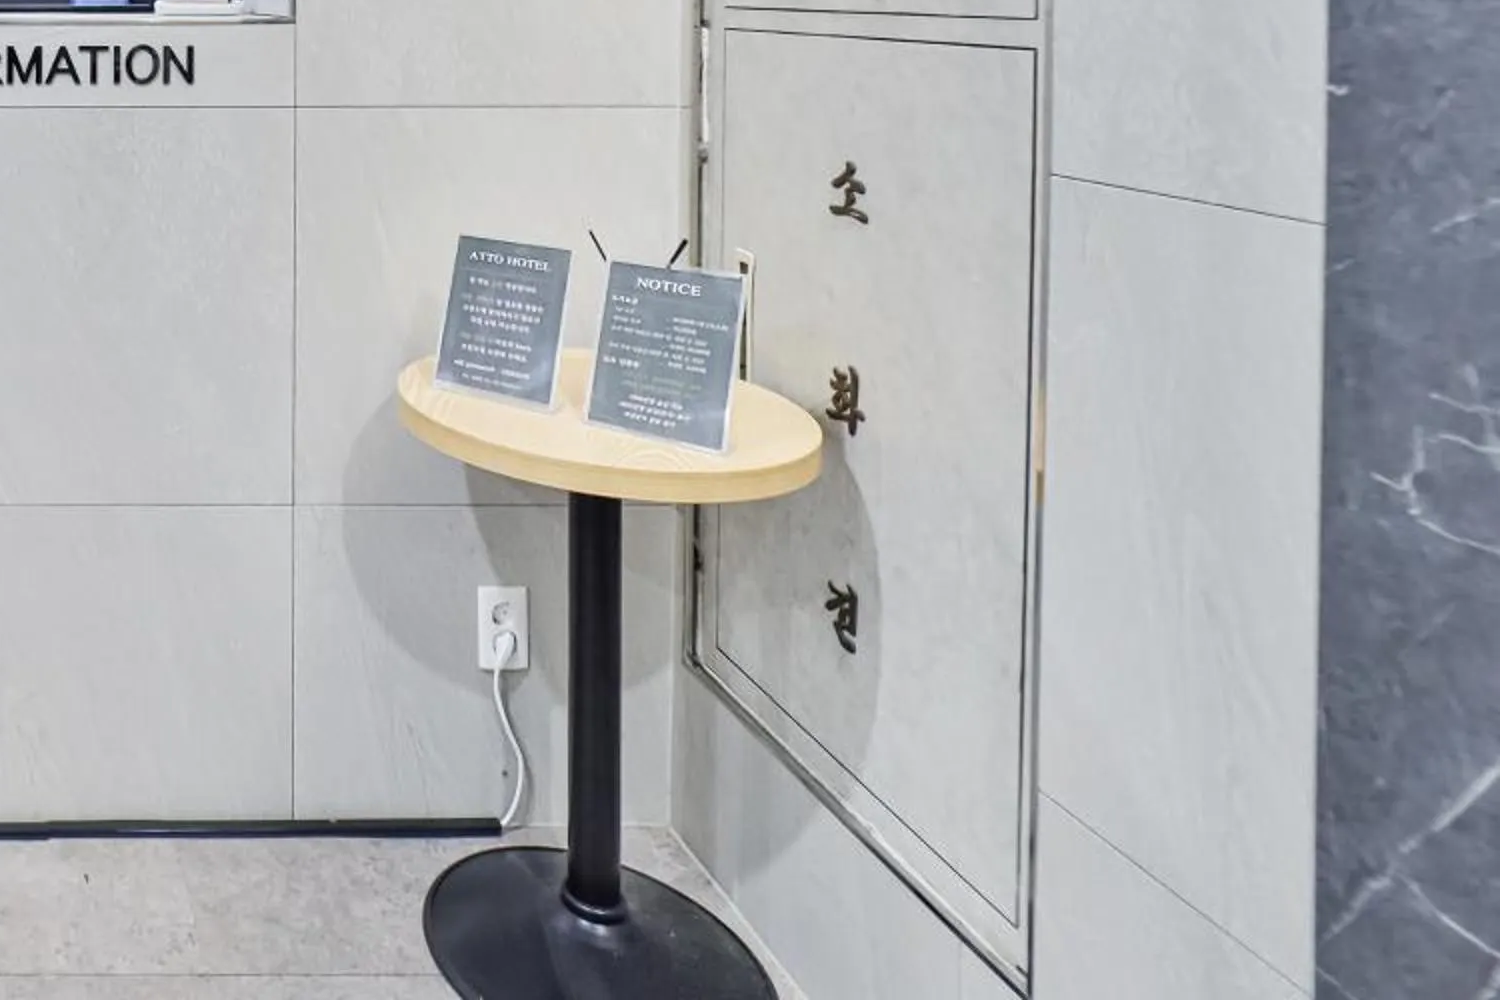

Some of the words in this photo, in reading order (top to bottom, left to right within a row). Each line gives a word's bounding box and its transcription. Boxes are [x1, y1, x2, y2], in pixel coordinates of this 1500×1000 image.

[469, 250, 504, 265] ATTO
[507, 256, 552, 272] HOTEL
[636, 277, 703, 297] NOTICE
